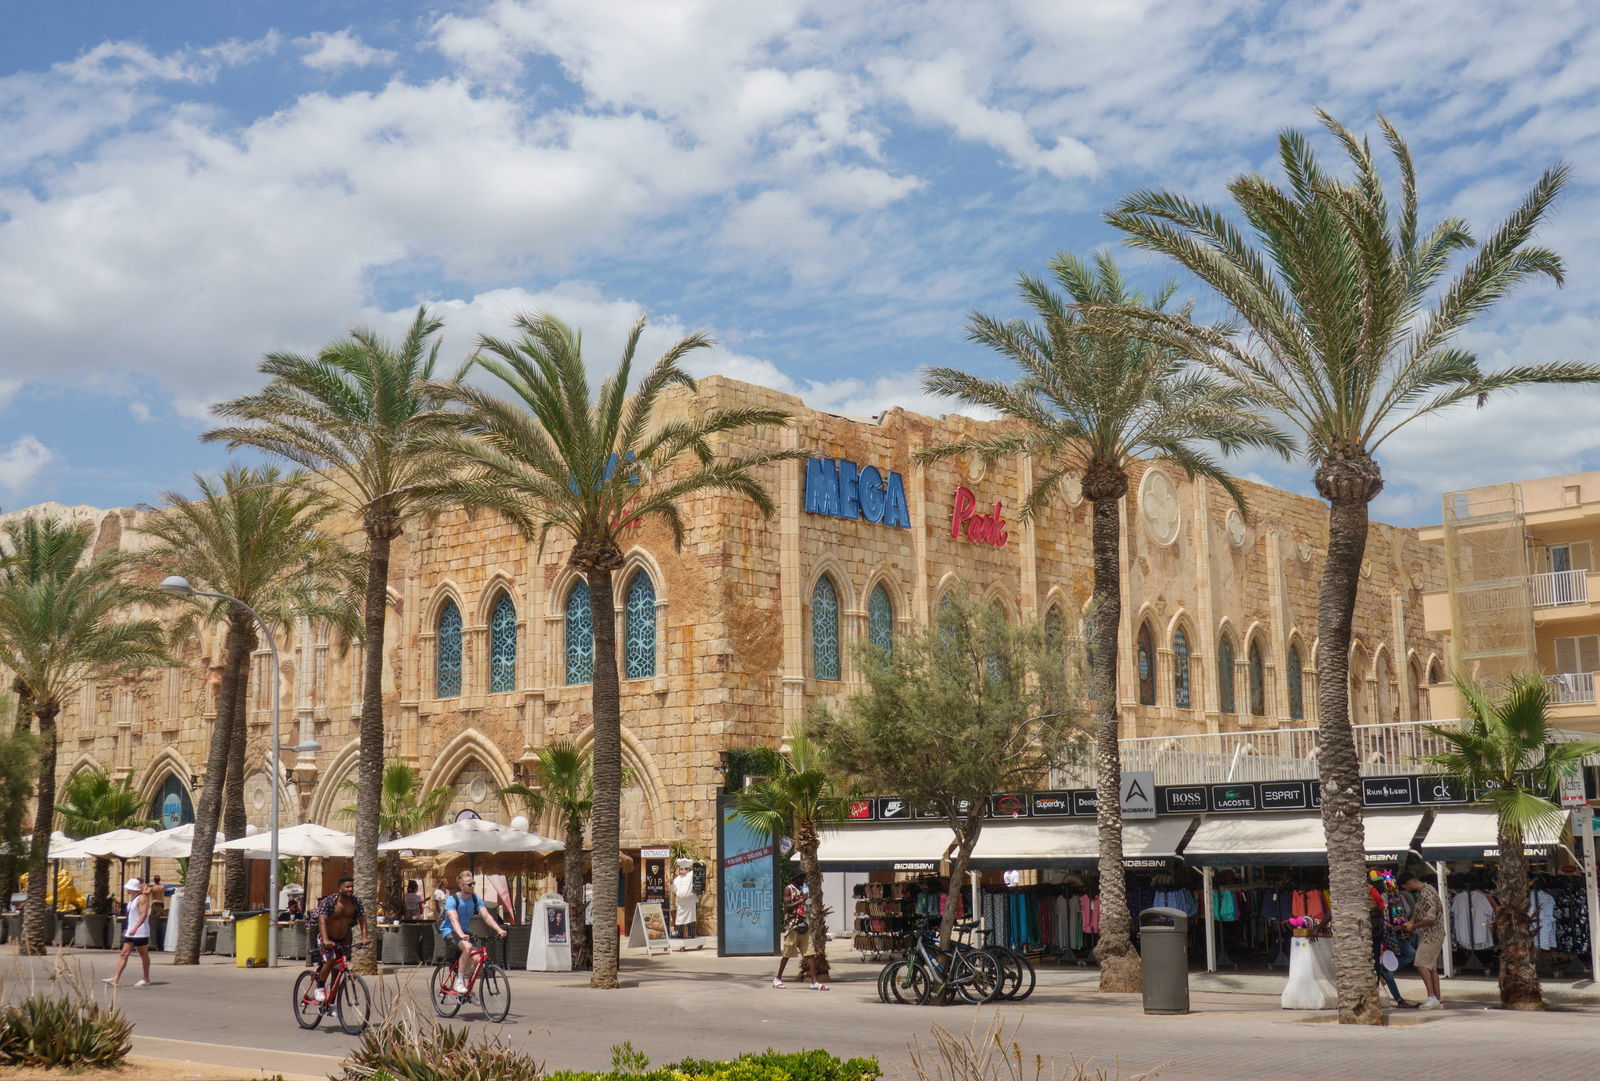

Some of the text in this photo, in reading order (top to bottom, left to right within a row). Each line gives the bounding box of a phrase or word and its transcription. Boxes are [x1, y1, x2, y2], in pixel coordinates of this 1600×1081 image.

[805, 457, 1009, 547] MEGA Park
[1173, 793, 1201, 802] BOSS
[1265, 790, 1300, 801] ESPRIT
[888, 801, 901, 810] NIKE
[1079, 798, 1099, 807] Desig
[726, 889, 772, 912] WHITE
